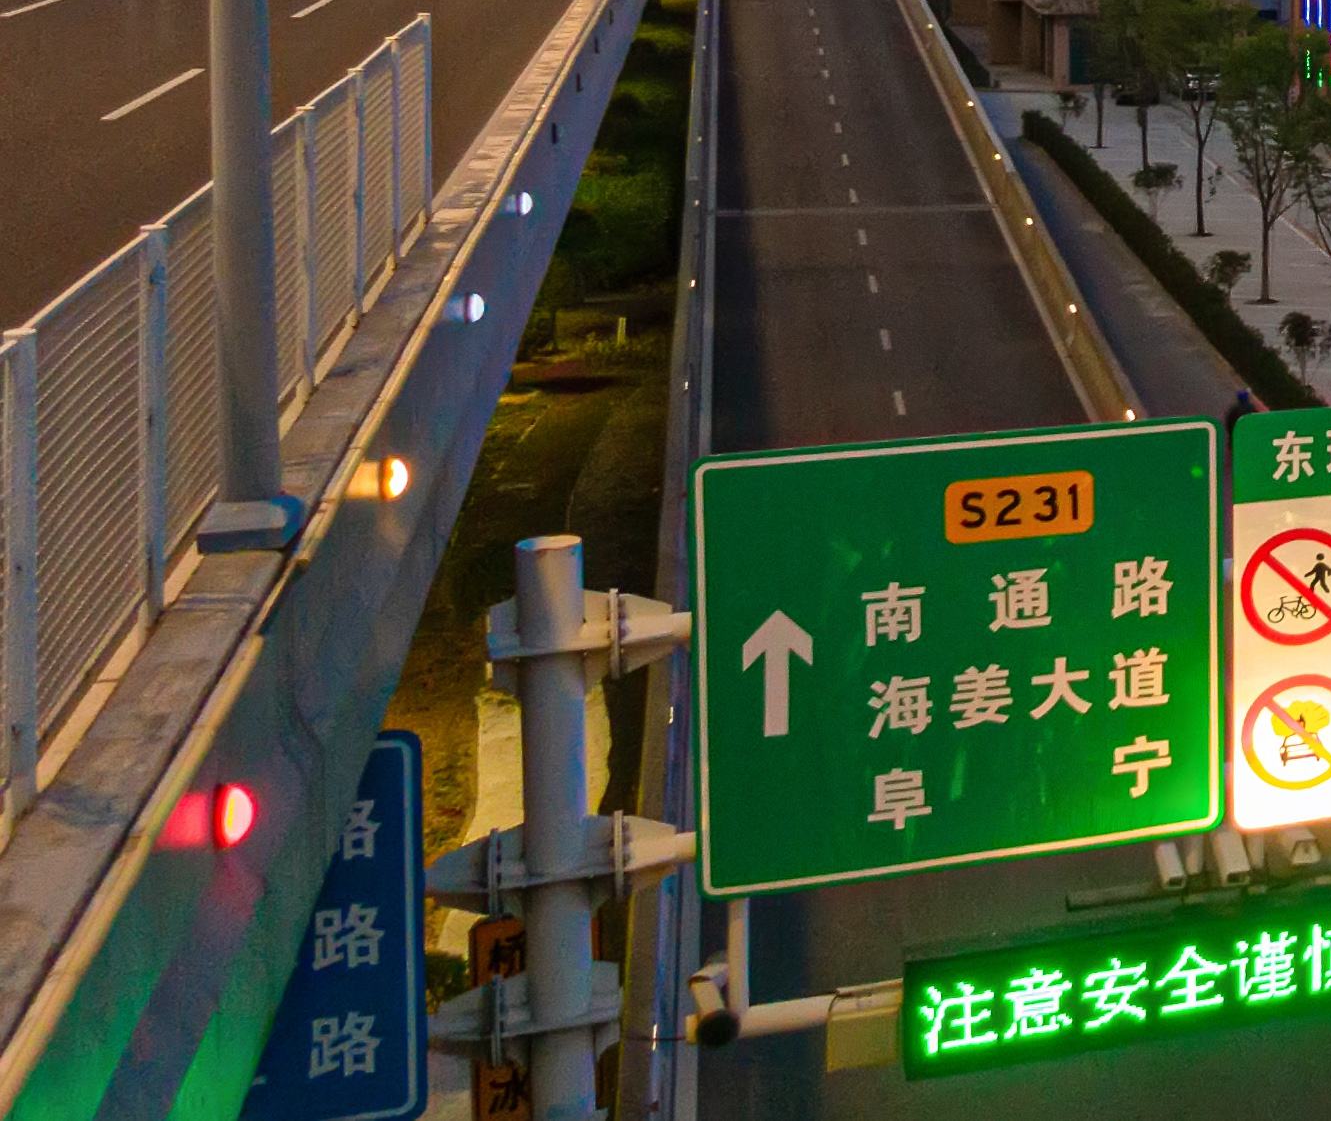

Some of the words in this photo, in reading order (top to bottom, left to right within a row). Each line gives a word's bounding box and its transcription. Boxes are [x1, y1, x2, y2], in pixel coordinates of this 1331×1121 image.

[960, 483, 1081, 529] S231
[861, 555, 1174, 647] 南通路
[867, 646, 1170, 740] 海姜大道
